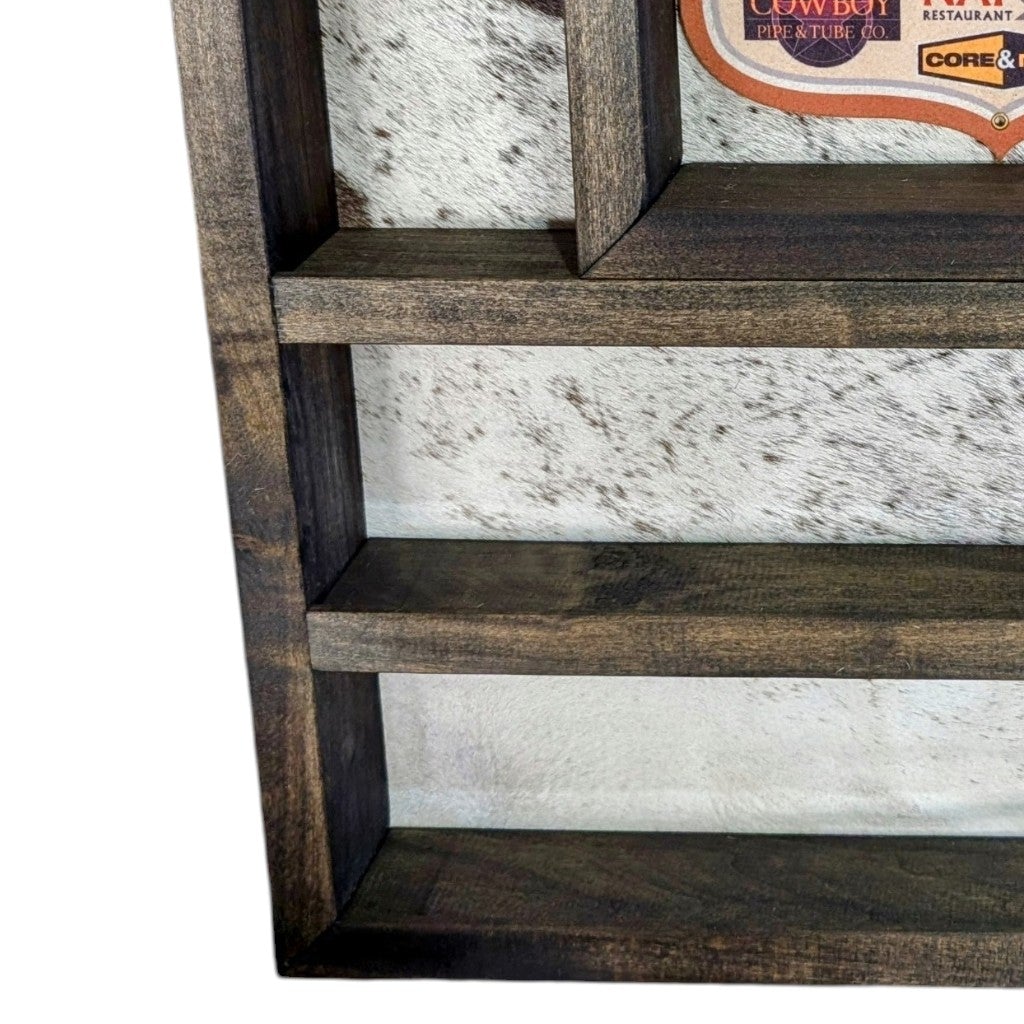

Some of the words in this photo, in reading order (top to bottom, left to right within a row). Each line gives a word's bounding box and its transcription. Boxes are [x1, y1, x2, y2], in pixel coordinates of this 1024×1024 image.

[923, 9, 1013, 21] RESTAURANT
[757, 25, 793, 39] PIPE
[808, 25, 855, 39] TUBE
[861, 25, 889, 39] CO.
